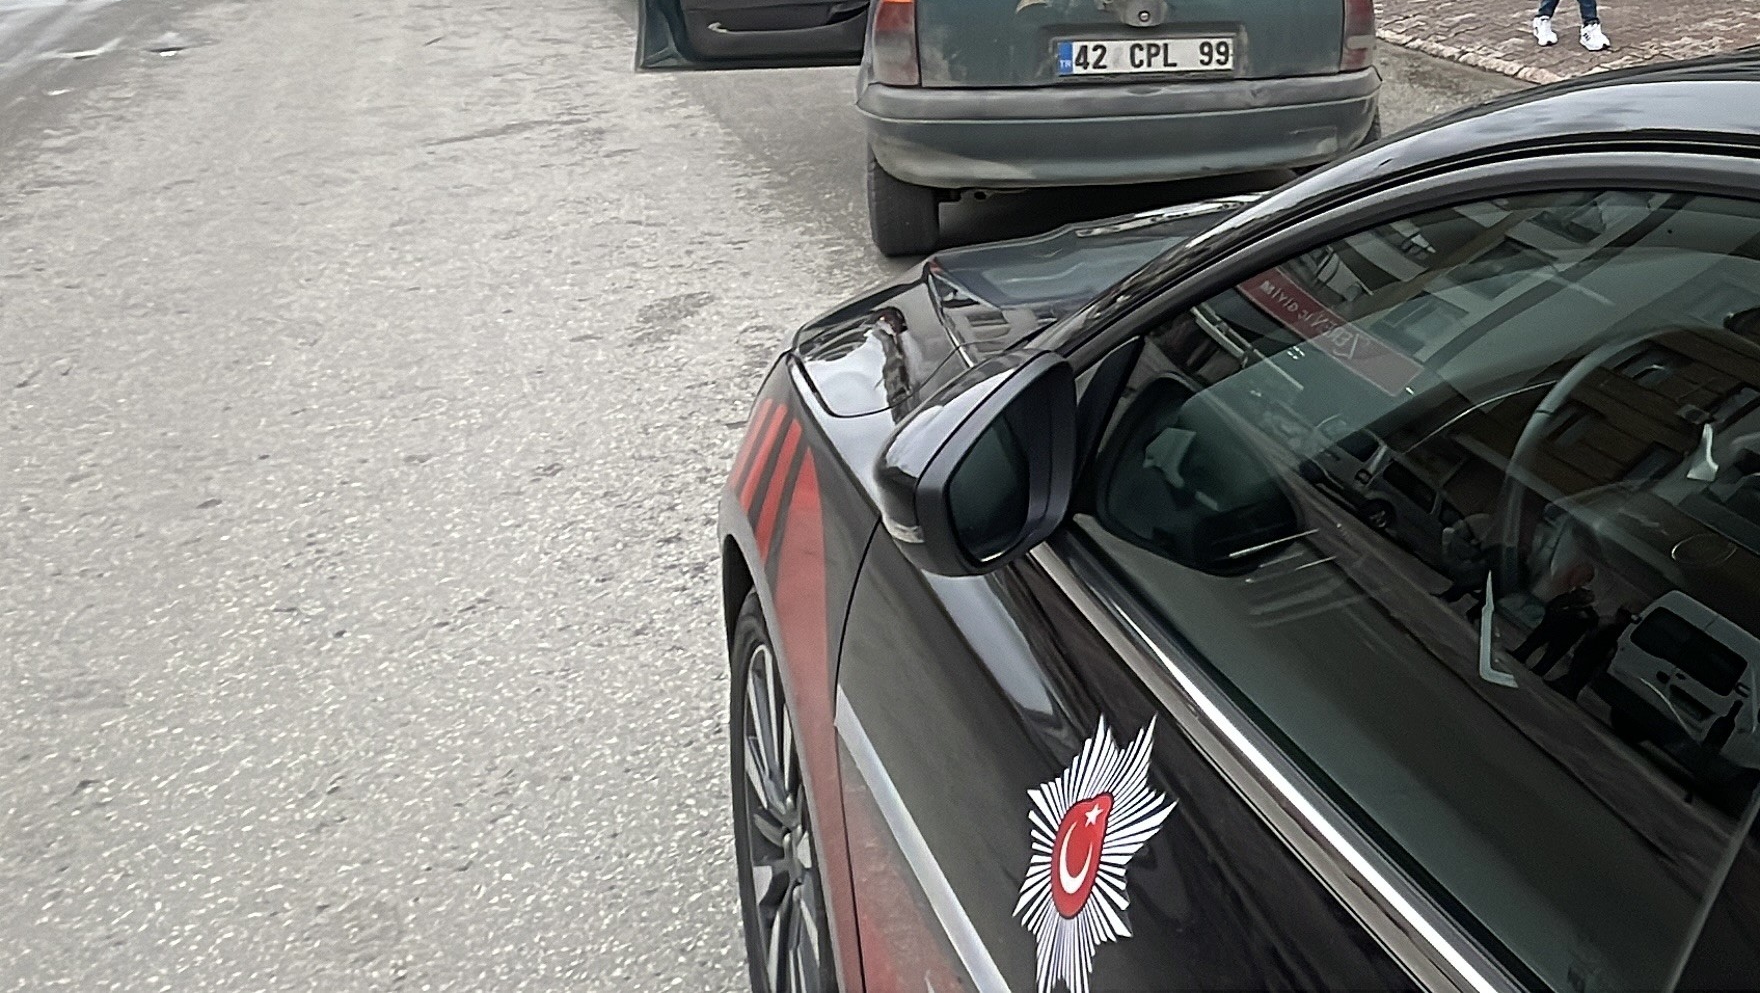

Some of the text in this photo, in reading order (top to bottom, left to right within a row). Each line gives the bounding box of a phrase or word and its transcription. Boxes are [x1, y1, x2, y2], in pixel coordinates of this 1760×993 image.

[1074, 41, 1230, 70] 42 CPL 99
